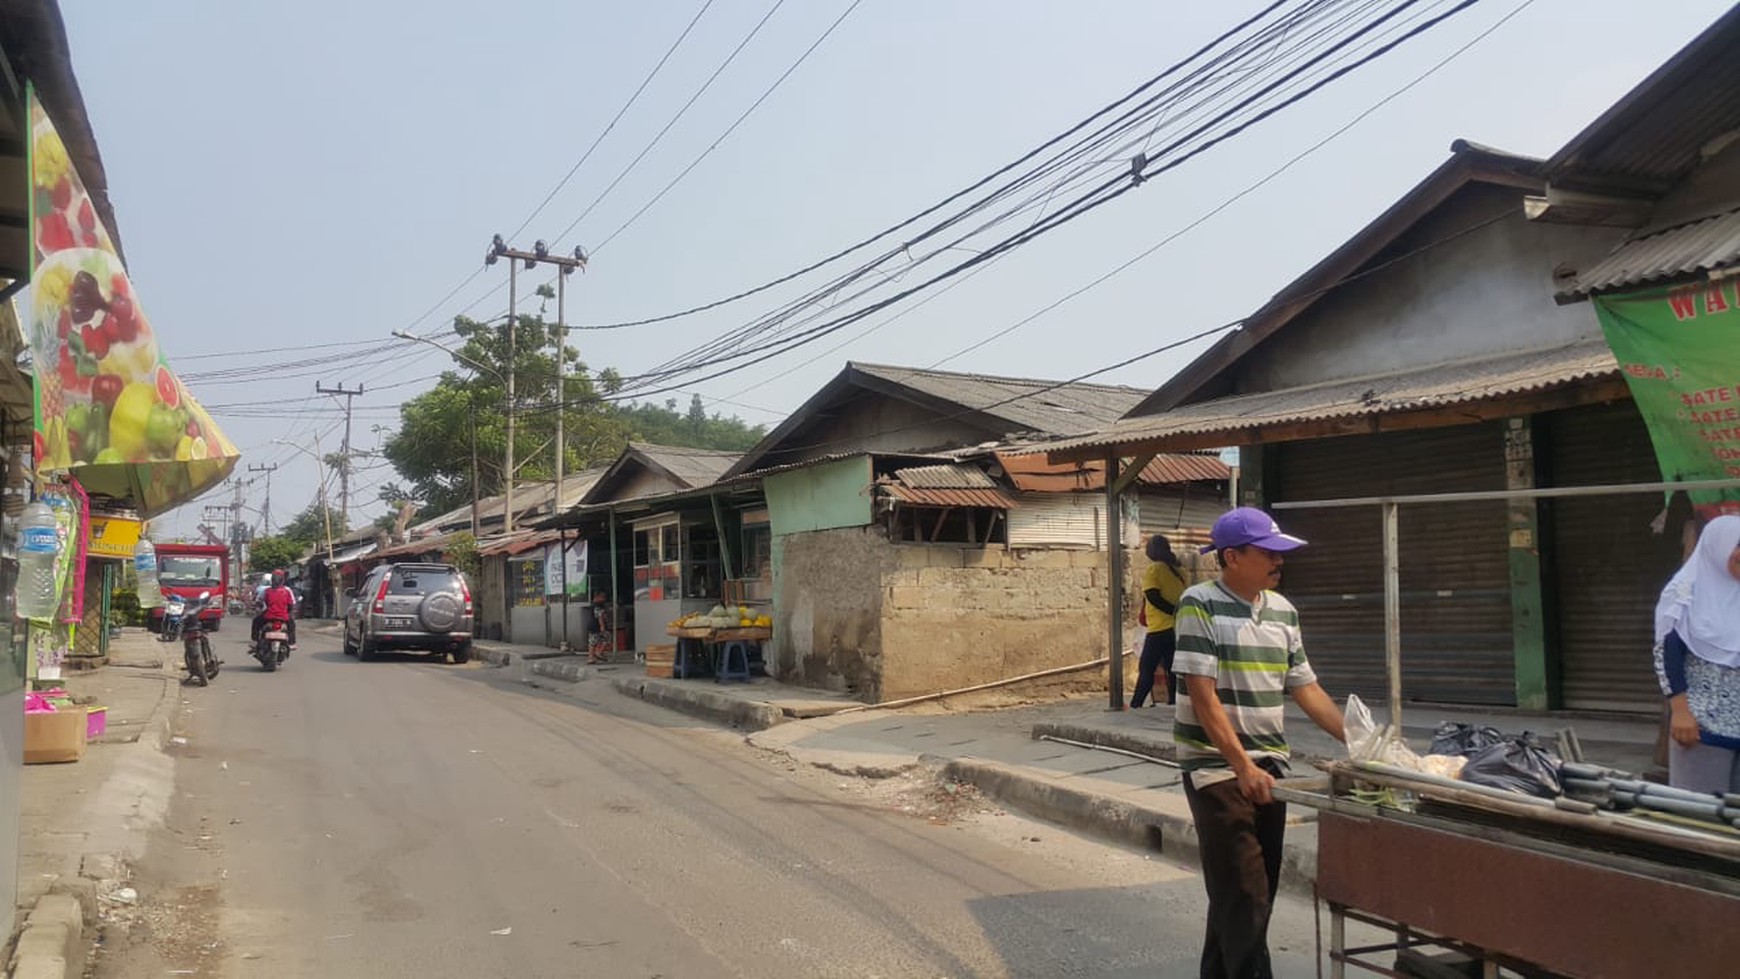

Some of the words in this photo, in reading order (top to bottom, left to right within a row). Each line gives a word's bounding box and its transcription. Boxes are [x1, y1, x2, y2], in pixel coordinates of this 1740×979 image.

[1668, 281, 1740, 321] WA
[1681, 386, 1732, 408] SATE
[1690, 407, 1737, 424] SATE
